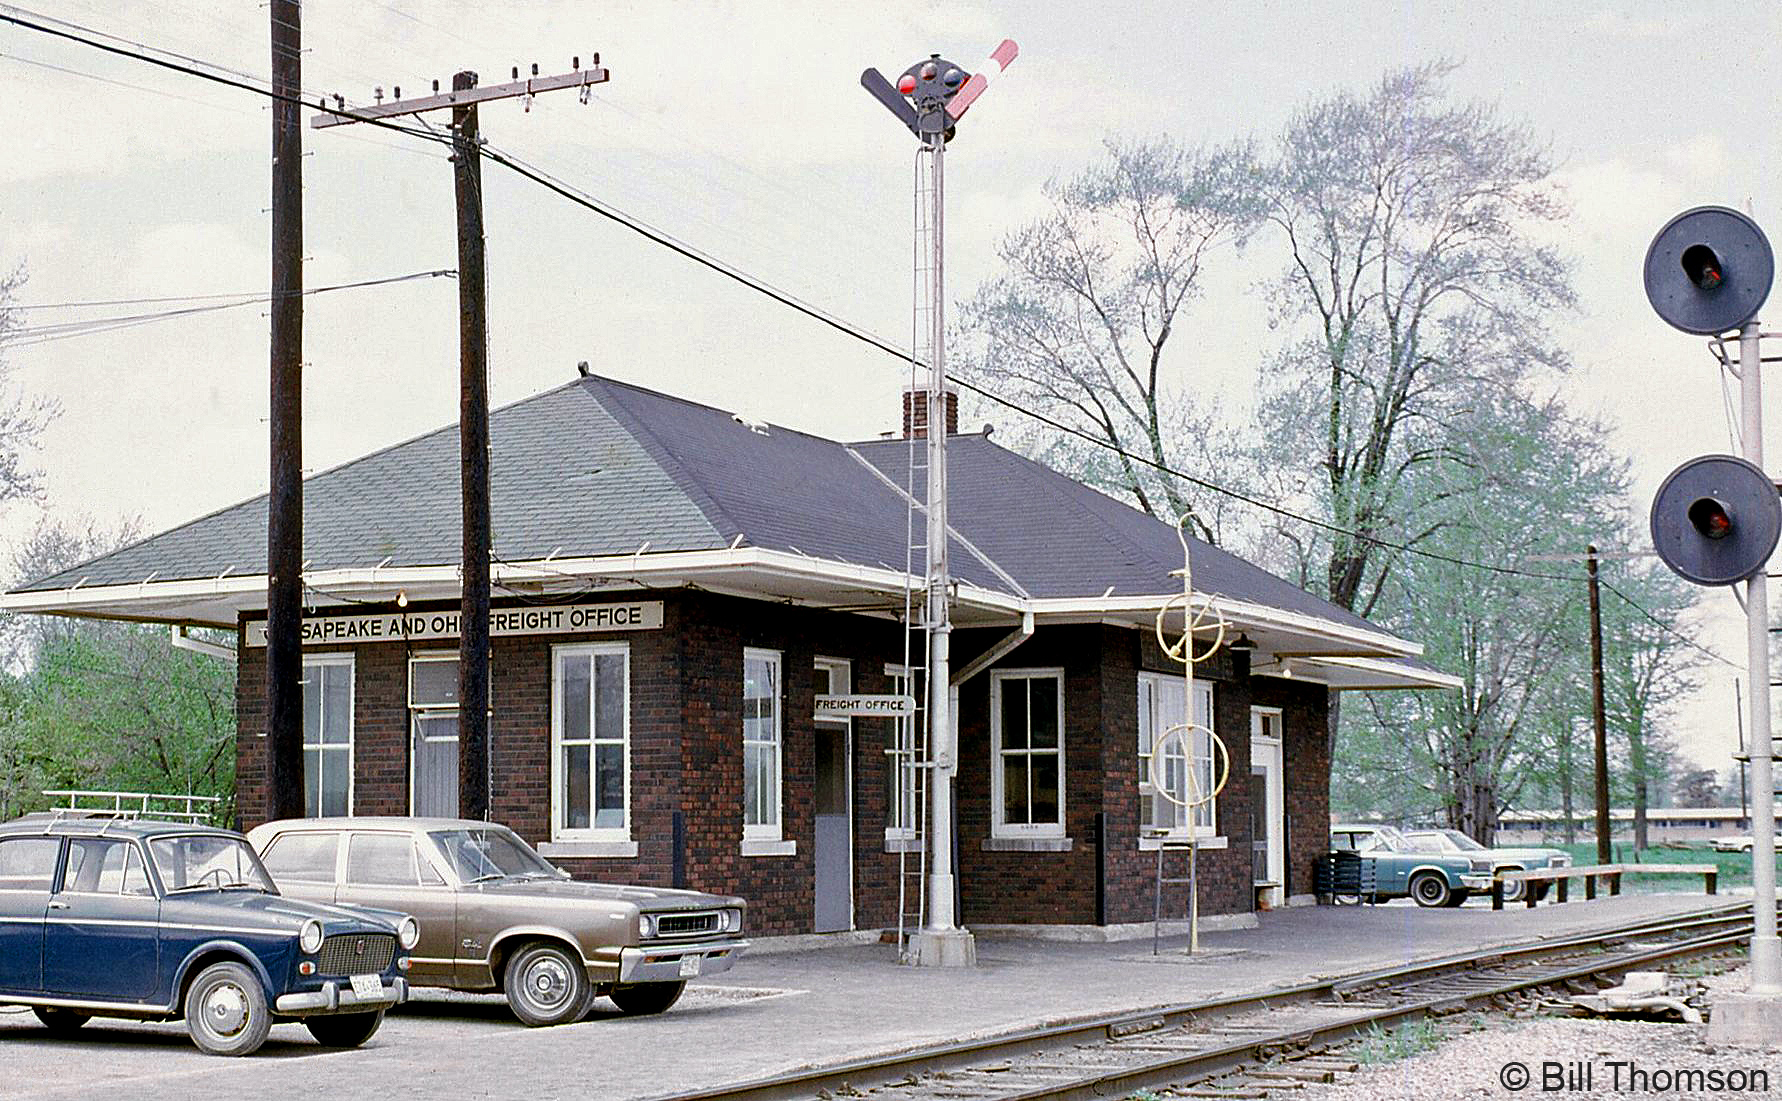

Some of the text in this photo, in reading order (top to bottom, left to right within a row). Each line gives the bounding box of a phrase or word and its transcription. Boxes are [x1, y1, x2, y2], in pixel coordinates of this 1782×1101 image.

[263, 607, 642, 640] SAPEAKE AND OHI FREIGHT OFFICE
[815, 699, 905, 711] FREIGHT OFFICE
